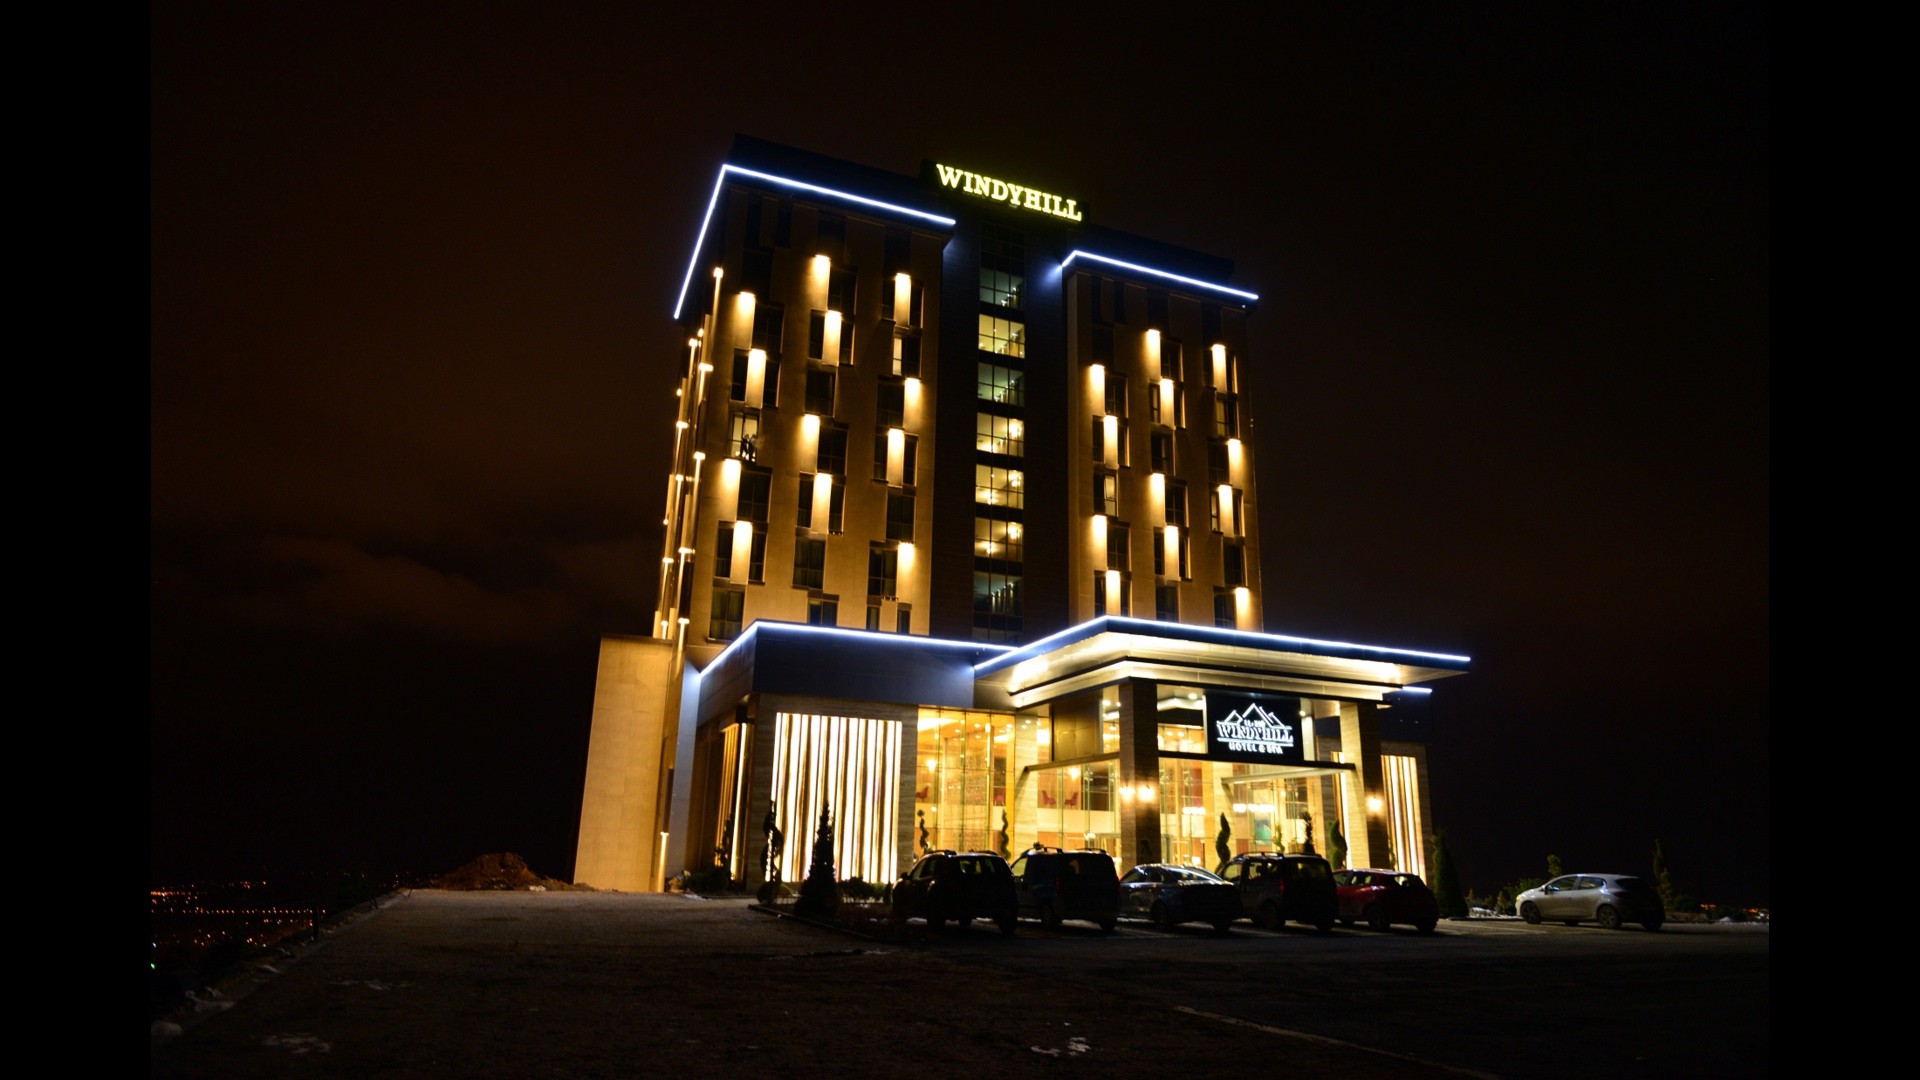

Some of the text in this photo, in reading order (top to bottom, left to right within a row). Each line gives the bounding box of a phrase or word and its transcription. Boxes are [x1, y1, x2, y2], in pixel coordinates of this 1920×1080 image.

[936, 163, 1082, 222] WINDYHILL
[1217, 723, 1294, 743] WINDYHILL
[1228, 742, 1258, 752] HOTEL
[1266, 744, 1283, 754] SPA
